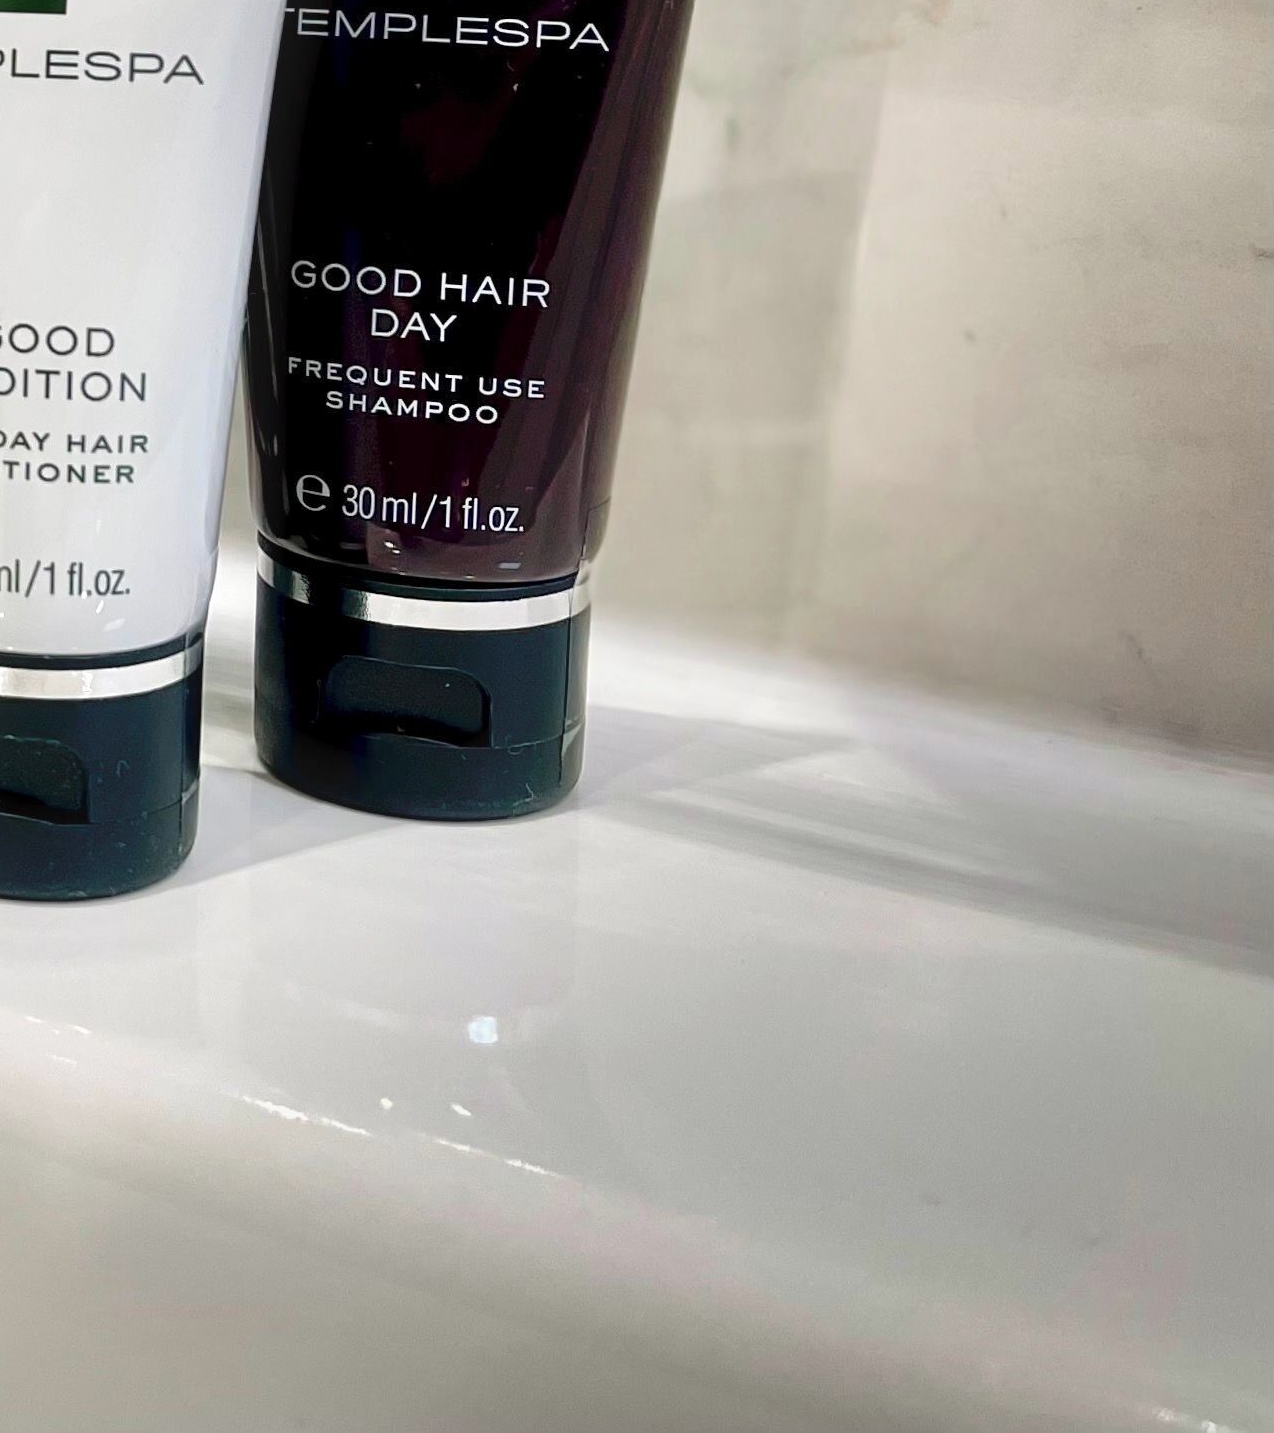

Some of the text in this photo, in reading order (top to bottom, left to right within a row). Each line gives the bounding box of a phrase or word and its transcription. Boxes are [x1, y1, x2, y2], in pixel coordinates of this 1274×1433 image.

[284, 7, 609, 52] EMPLESPA
[291, 260, 550, 308] GOOD HAIR
[371, 308, 457, 342] DAY
[288, 357, 545, 398] FREQUENT USE
[326, 391, 498, 424] SHAMPOO
[67, 434, 148, 453] HAIR
